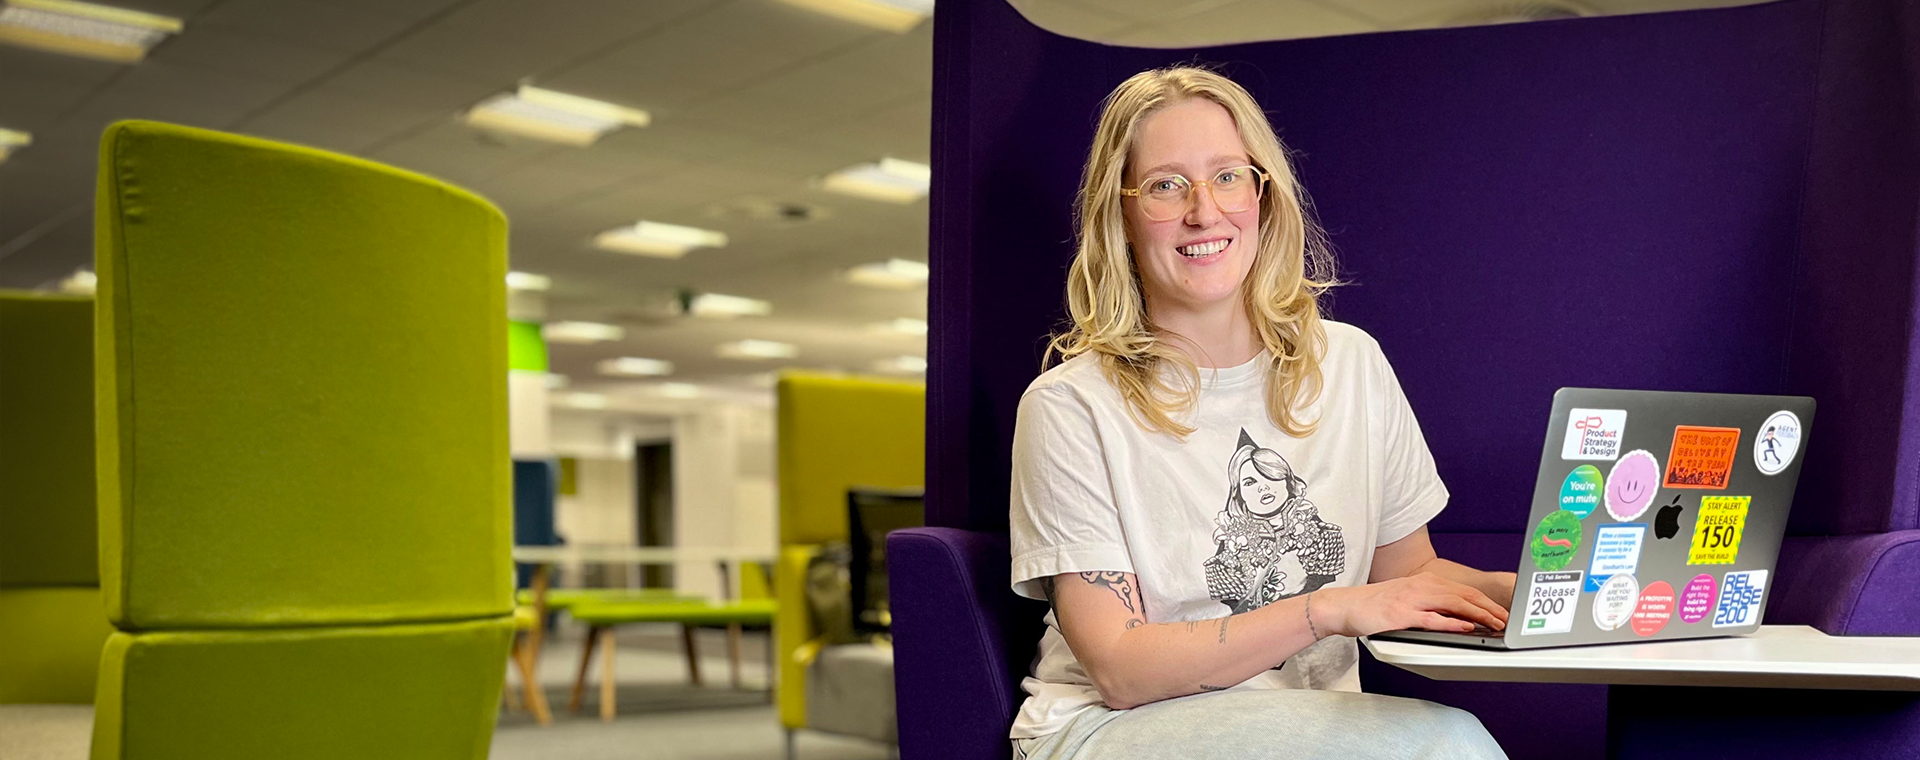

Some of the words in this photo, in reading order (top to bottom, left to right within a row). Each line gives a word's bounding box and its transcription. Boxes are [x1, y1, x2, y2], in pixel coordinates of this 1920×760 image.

[1586, 429, 1616, 438] Product
[1584, 438, 1616, 448] Strategy
[1680, 435, 1698, 445] THE
[1701, 436, 1721, 446] UNIT
[1590, 447, 1616, 456] Design
[1570, 481, 1595, 490] You're
[1576, 494, 1597, 503] mute
[1707, 502, 1722, 510] STAY
[1704, 515, 1738, 525] RELEASE
[1702, 526, 1734, 548] 150
[1724, 574, 1754, 590] REL
[1534, 586, 1575, 597] Release
[1720, 589, 1762, 606] EASE
[1530, 598, 1564, 615] 200
[1714, 605, 1748, 624] 200
